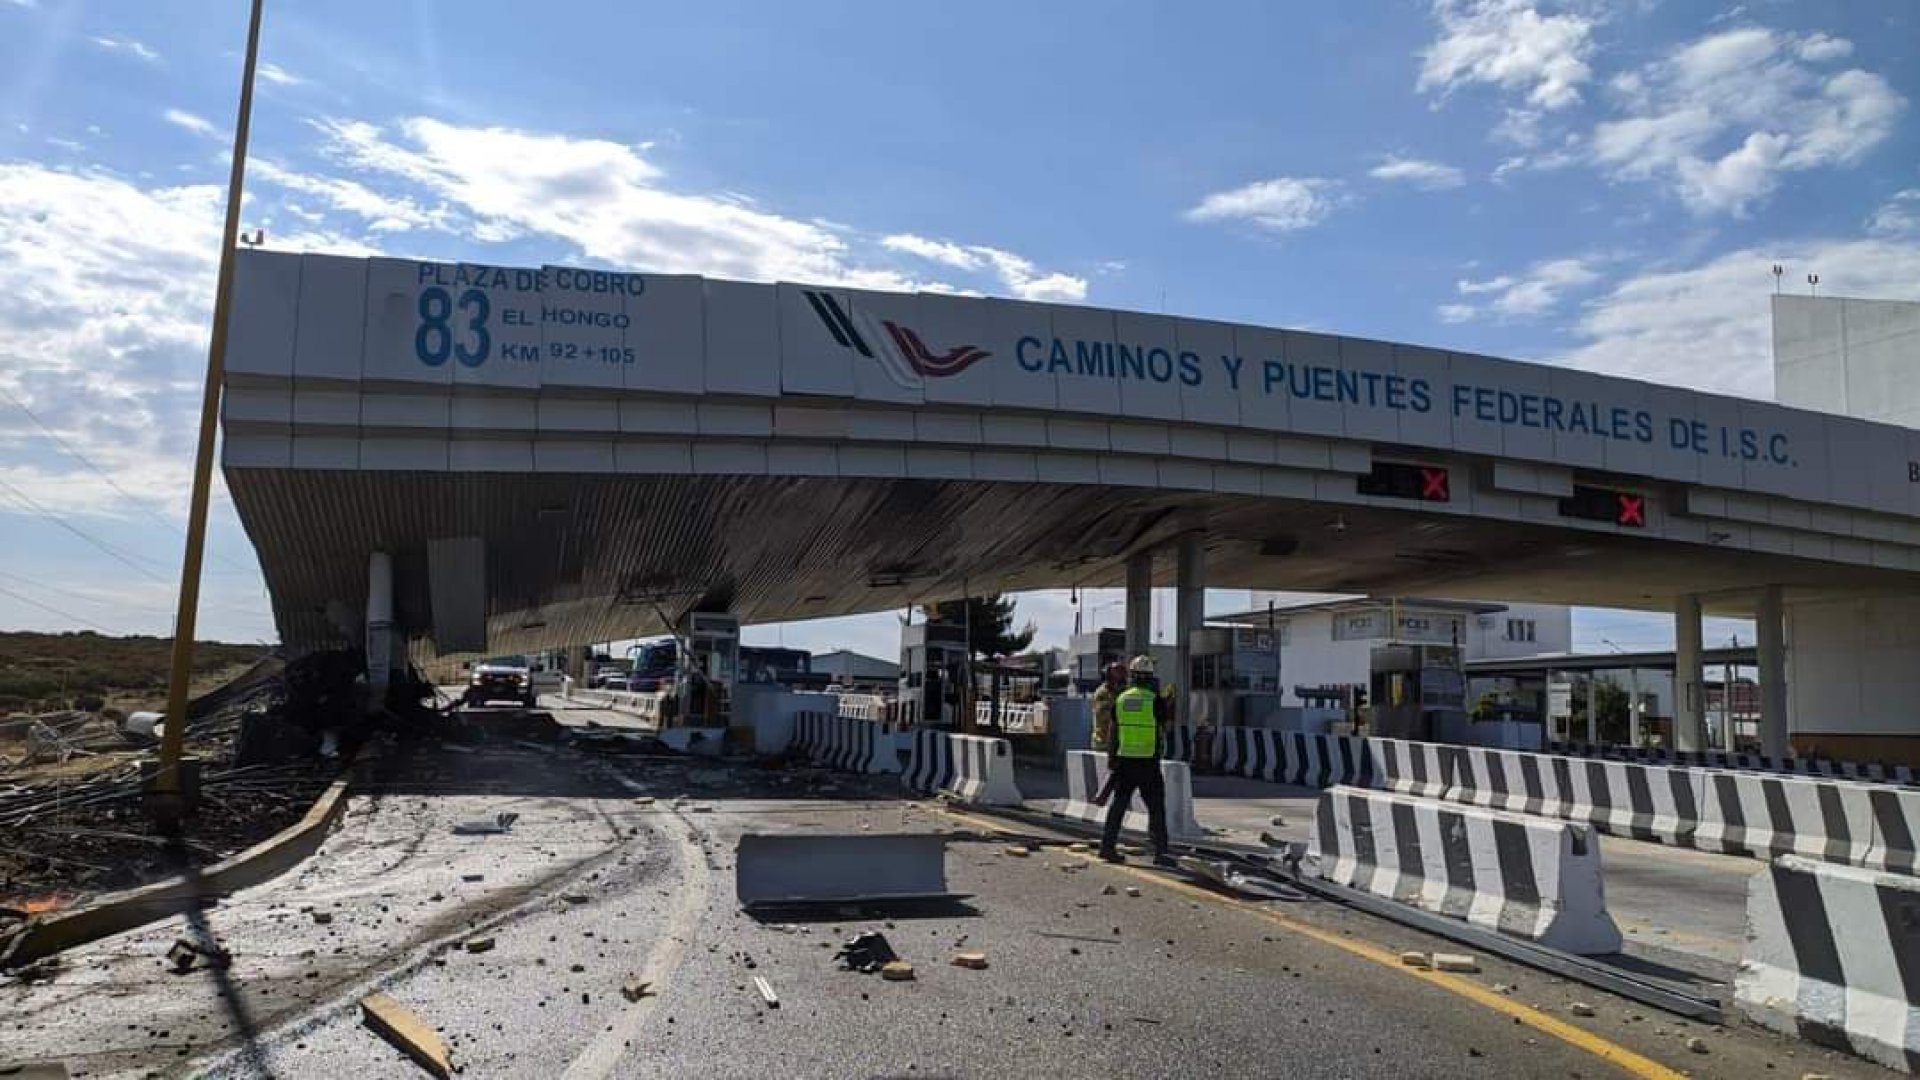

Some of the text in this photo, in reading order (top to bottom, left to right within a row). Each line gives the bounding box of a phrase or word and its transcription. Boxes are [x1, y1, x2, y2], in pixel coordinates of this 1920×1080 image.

[418, 263, 645, 297] PLAZA DE COBRO
[415, 286, 491, 368] 83
[502, 304, 631, 330] EL HONGO
[502, 343, 540, 363] KM
[1015, 335, 1798, 467] CAMINOS Y PUENTES FEDERALES DE I.S.C.
